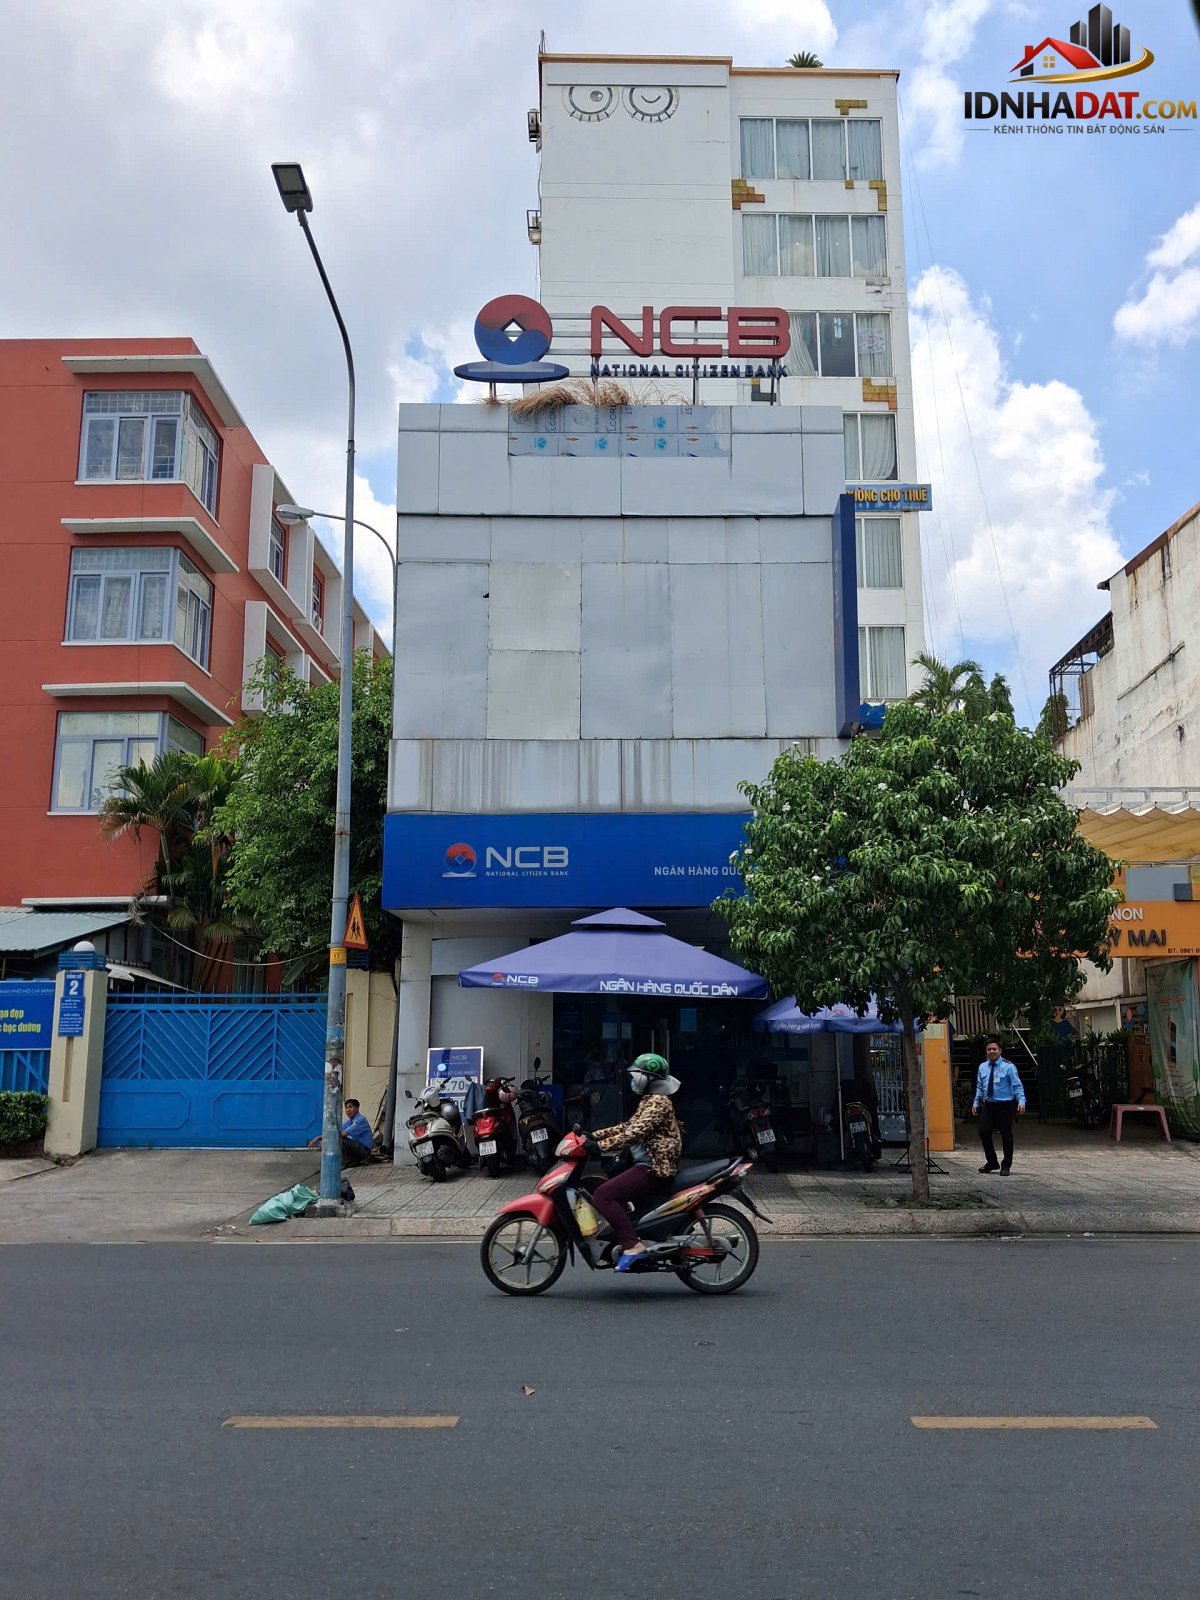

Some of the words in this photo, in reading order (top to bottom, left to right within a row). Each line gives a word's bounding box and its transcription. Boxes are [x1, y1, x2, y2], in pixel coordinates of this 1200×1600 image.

[590, 305, 791, 358] NCB
[590, 364, 669, 377] NATIONAL
[675, 364, 741, 377] CITIZEN
[745, 365, 788, 378] BANK
[880, 489, 901, 502] CHO
[902, 486, 928, 502] THUÊ
[485, 846, 569, 868] NCB
[654, 864, 685, 876] NGÂN
[688, 864, 719, 876] HÀNG
[1128, 929, 1167, 947] MAI
[506, 974, 539, 984] NCB
[599, 977, 635, 992] NGÂN
[637, 979, 672, 994] HÀNG
[674, 981, 709, 995] QUỐC
[711, 982, 738, 996] DÂN
[69, 980, 79, 995] 2
